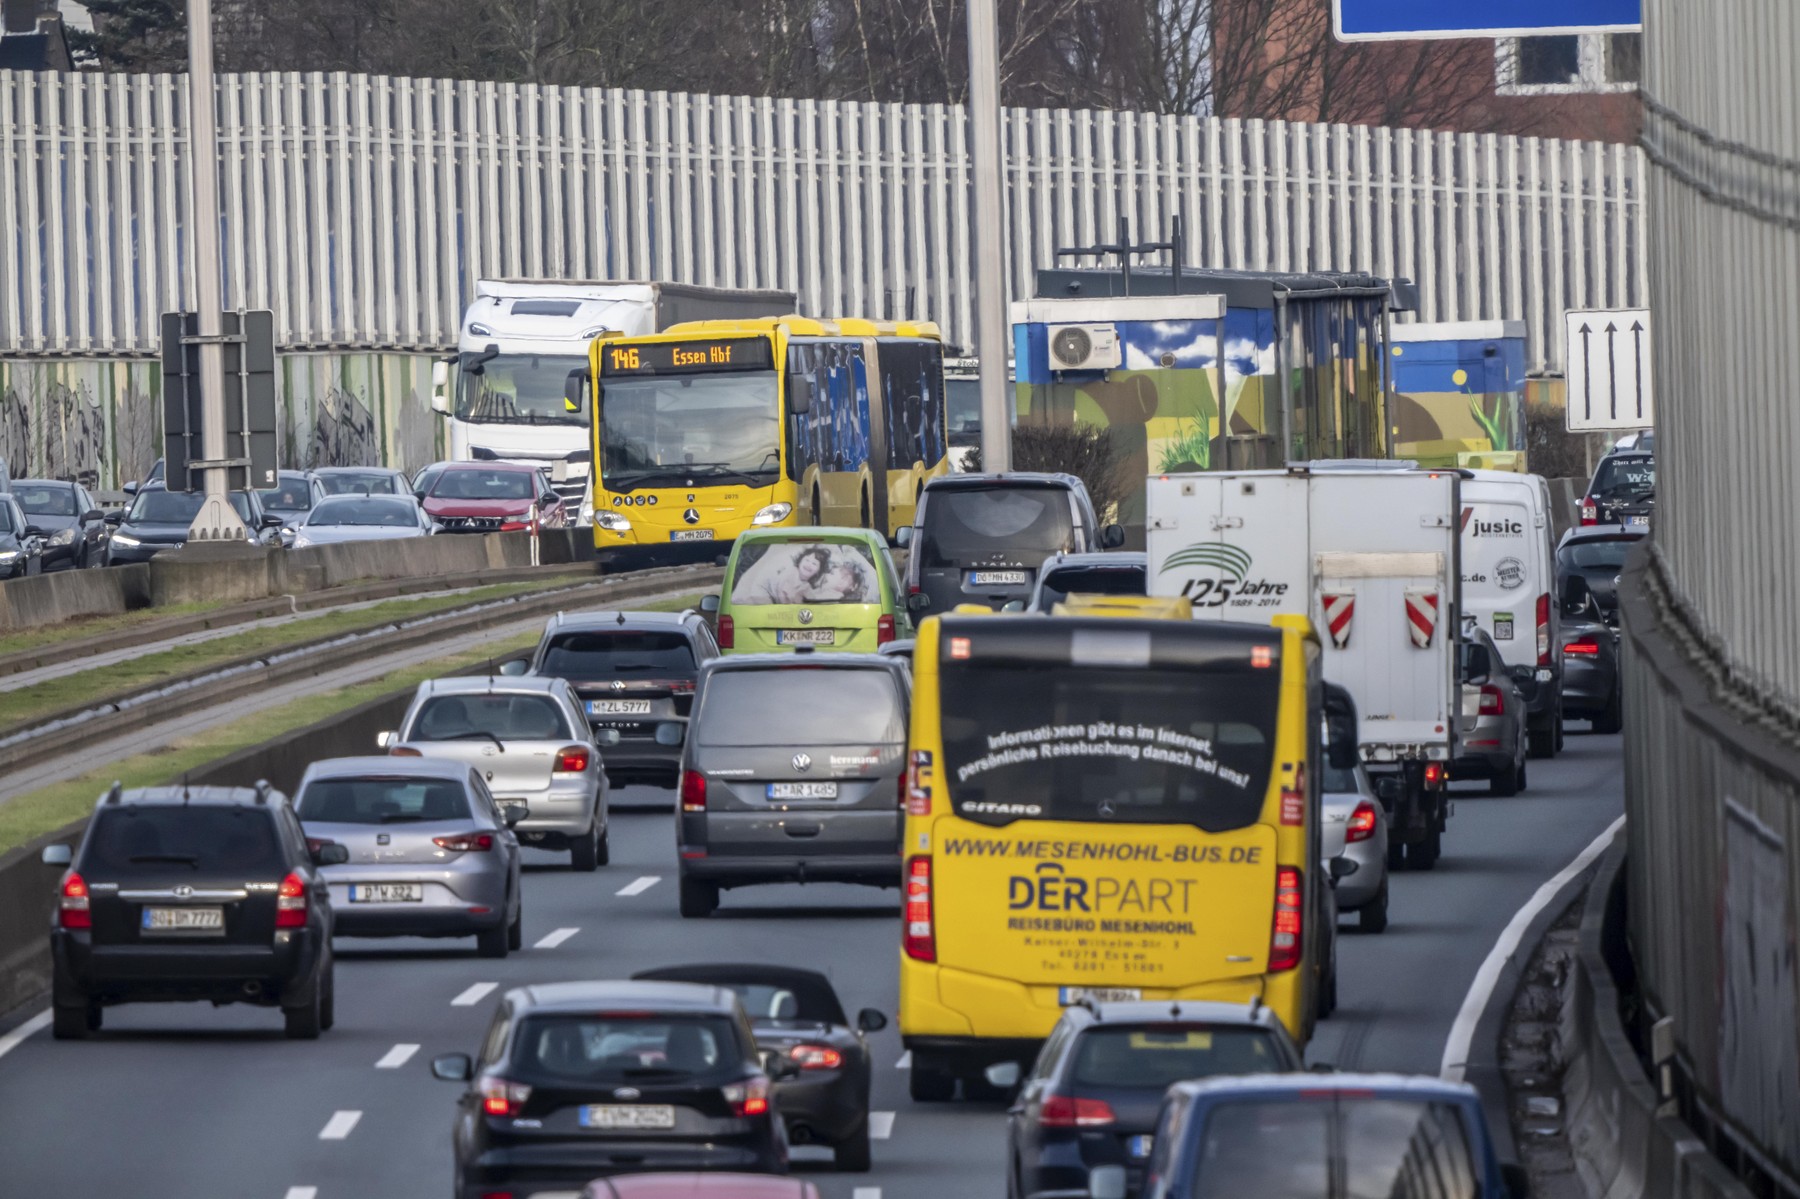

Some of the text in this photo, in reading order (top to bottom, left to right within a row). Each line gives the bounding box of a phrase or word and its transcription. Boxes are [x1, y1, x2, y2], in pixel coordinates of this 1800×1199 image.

[611, 346, 732, 370] 146 Essen Hbf
[696, 530, 713, 539] 2075
[1473, 518, 1523, 538] jusic
[1180, 578, 1288, 607] 125 Jahre
[783, 631, 797, 641] KK
[815, 631, 833, 641] 222
[607, 702, 620, 712] ZL
[622, 702, 649, 712] 5777
[988, 722, 1213, 756] Informationen gibt es im Internet,
[957, 741, 1251, 788] persönliche Reisebuchung danach bei uns!
[961, 801, 1041, 815] CITARO
[944, 839, 1262, 865] WWW.MESENHOHL-BUS.DE
[191, 911, 221, 925] 7777
[1007, 915, 1196, 937] REISEBÜRO MESENHOHL
